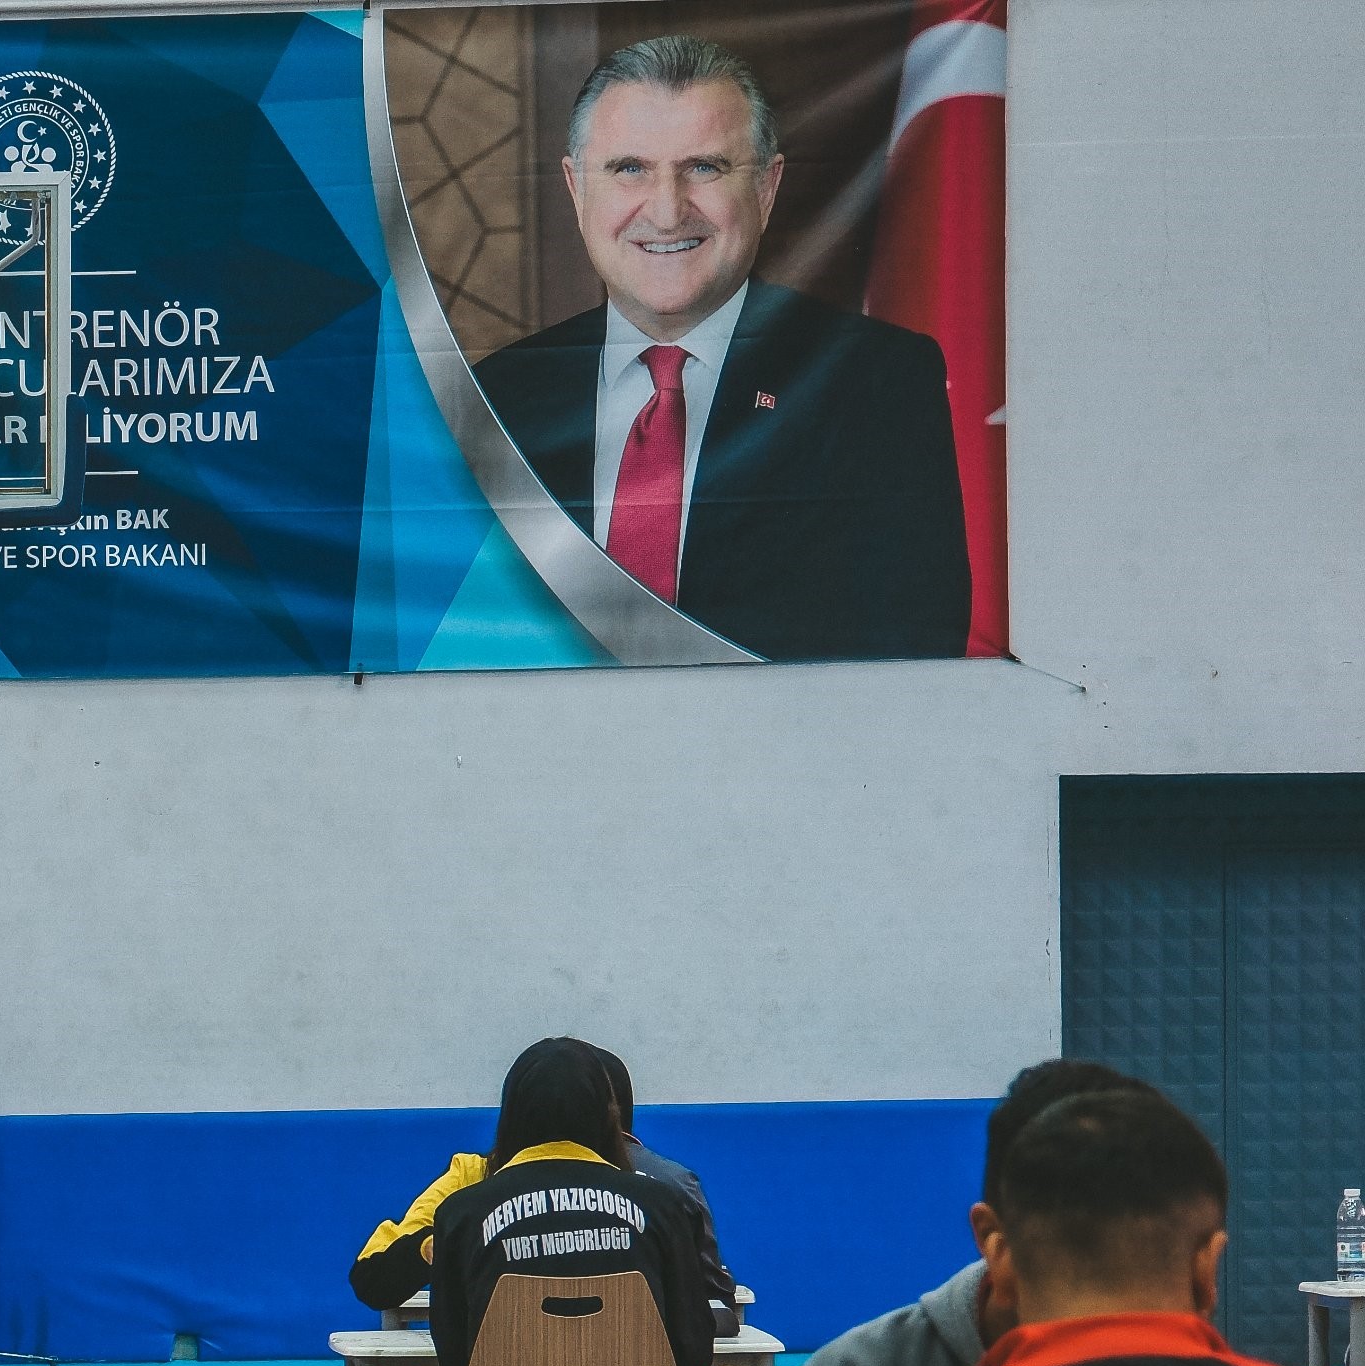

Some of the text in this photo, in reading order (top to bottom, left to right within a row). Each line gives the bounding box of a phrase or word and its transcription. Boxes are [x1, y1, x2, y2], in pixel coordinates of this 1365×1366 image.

[14, 102, 62, 119] GENÇLİK
[61, 114, 74, 130] VE
[70, 128, 85, 158] SPOR
[39, 407, 258, 444] LİYORUM
[116, 509, 170, 530] BAK
[26, 544, 97, 568] SPOR
[105, 542, 207, 568] BAKANI
[482, 1190, 548, 1247] MERYEM
[501, 1235, 539, 1262] YURT
